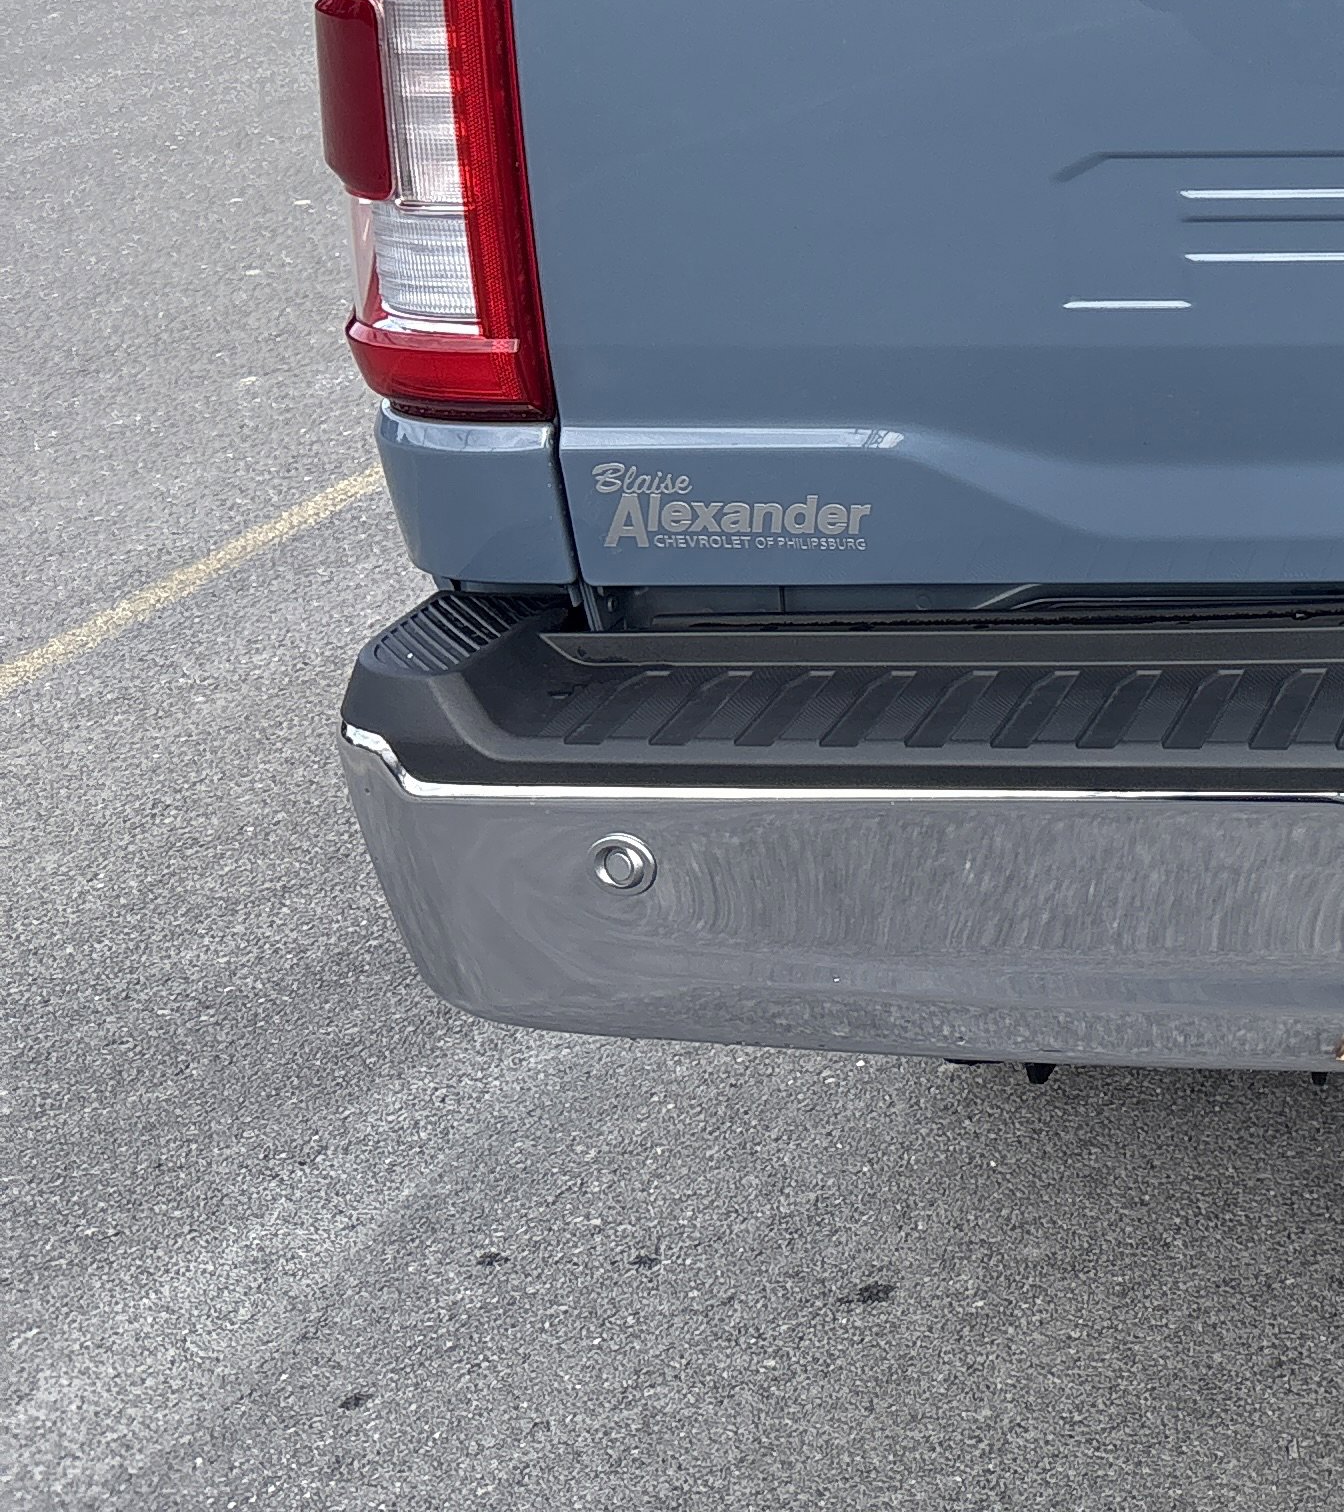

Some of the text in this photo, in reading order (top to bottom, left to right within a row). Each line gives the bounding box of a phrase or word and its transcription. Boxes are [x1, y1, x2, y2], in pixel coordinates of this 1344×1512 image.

[592, 462, 692, 495] Blaise
[604, 492, 872, 548] Alexander
[654, 535, 867, 551] CHEVROLET OF PHILIPSBURG
